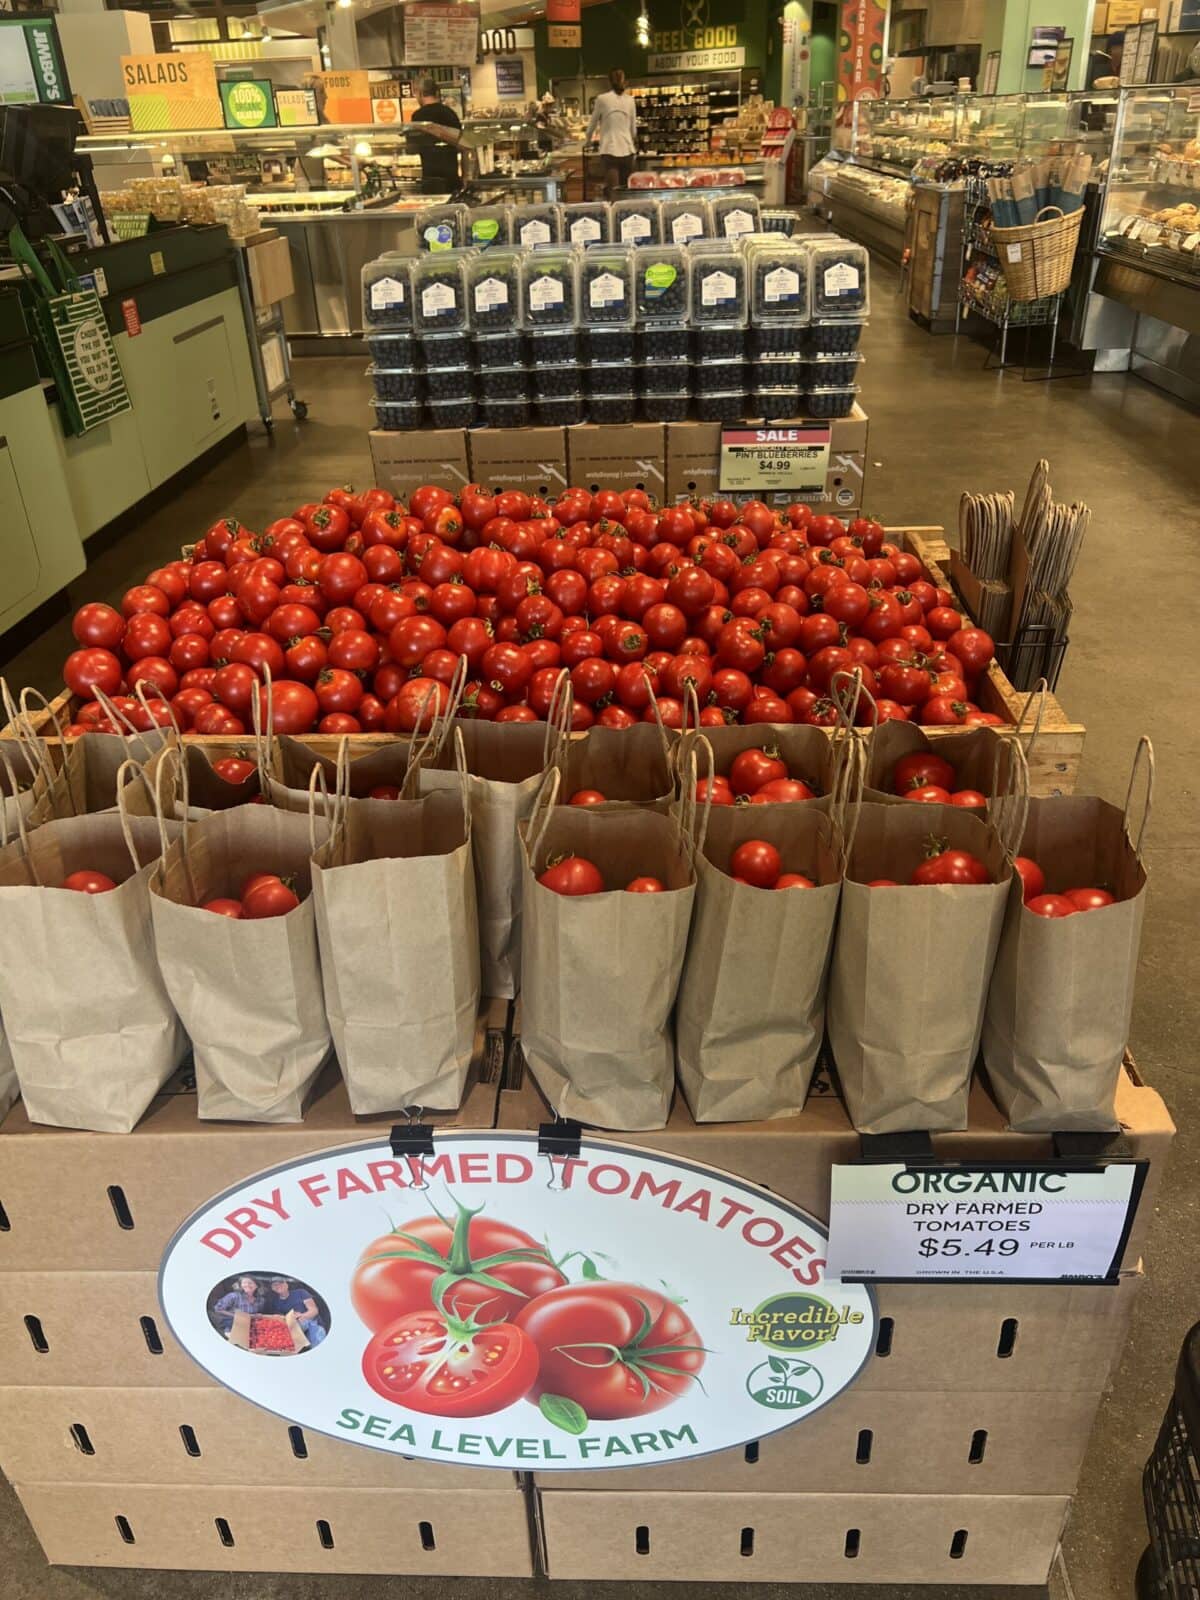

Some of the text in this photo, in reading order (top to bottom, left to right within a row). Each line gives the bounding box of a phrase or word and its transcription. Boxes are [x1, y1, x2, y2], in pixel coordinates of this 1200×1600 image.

[653, 25, 737, 53] FEEL GOOD
[32, 29, 61, 100] JIMBO'S
[655, 51, 737, 69] ABOUT YOUR FOOD
[125, 61, 188, 85] SALADS
[324, 76, 350, 88] FOODS
[233, 87, 262, 104] 100%
[756, 429, 799, 442] SALE
[735, 450, 818, 459] PINT BLUEBERRIES
[759, 460, 791, 470] $4.99
[891, 1171, 1069, 1194] ORGANIC
[906, 1202, 1043, 1216] DRY FARMED
[200, 1153, 827, 1286] DRY FARMED TOMATOES
[913, 1220, 1031, 1232] TOMATOES
[918, 1238, 1075, 1258] $5.49 PER LB
[729, 1305, 864, 1326] Incredible
[746, 1323, 840, 1343] Flavor!
[766, 1388, 801, 1404] SOIL
[335, 1408, 699, 1459] SEA LEVEL FARM
